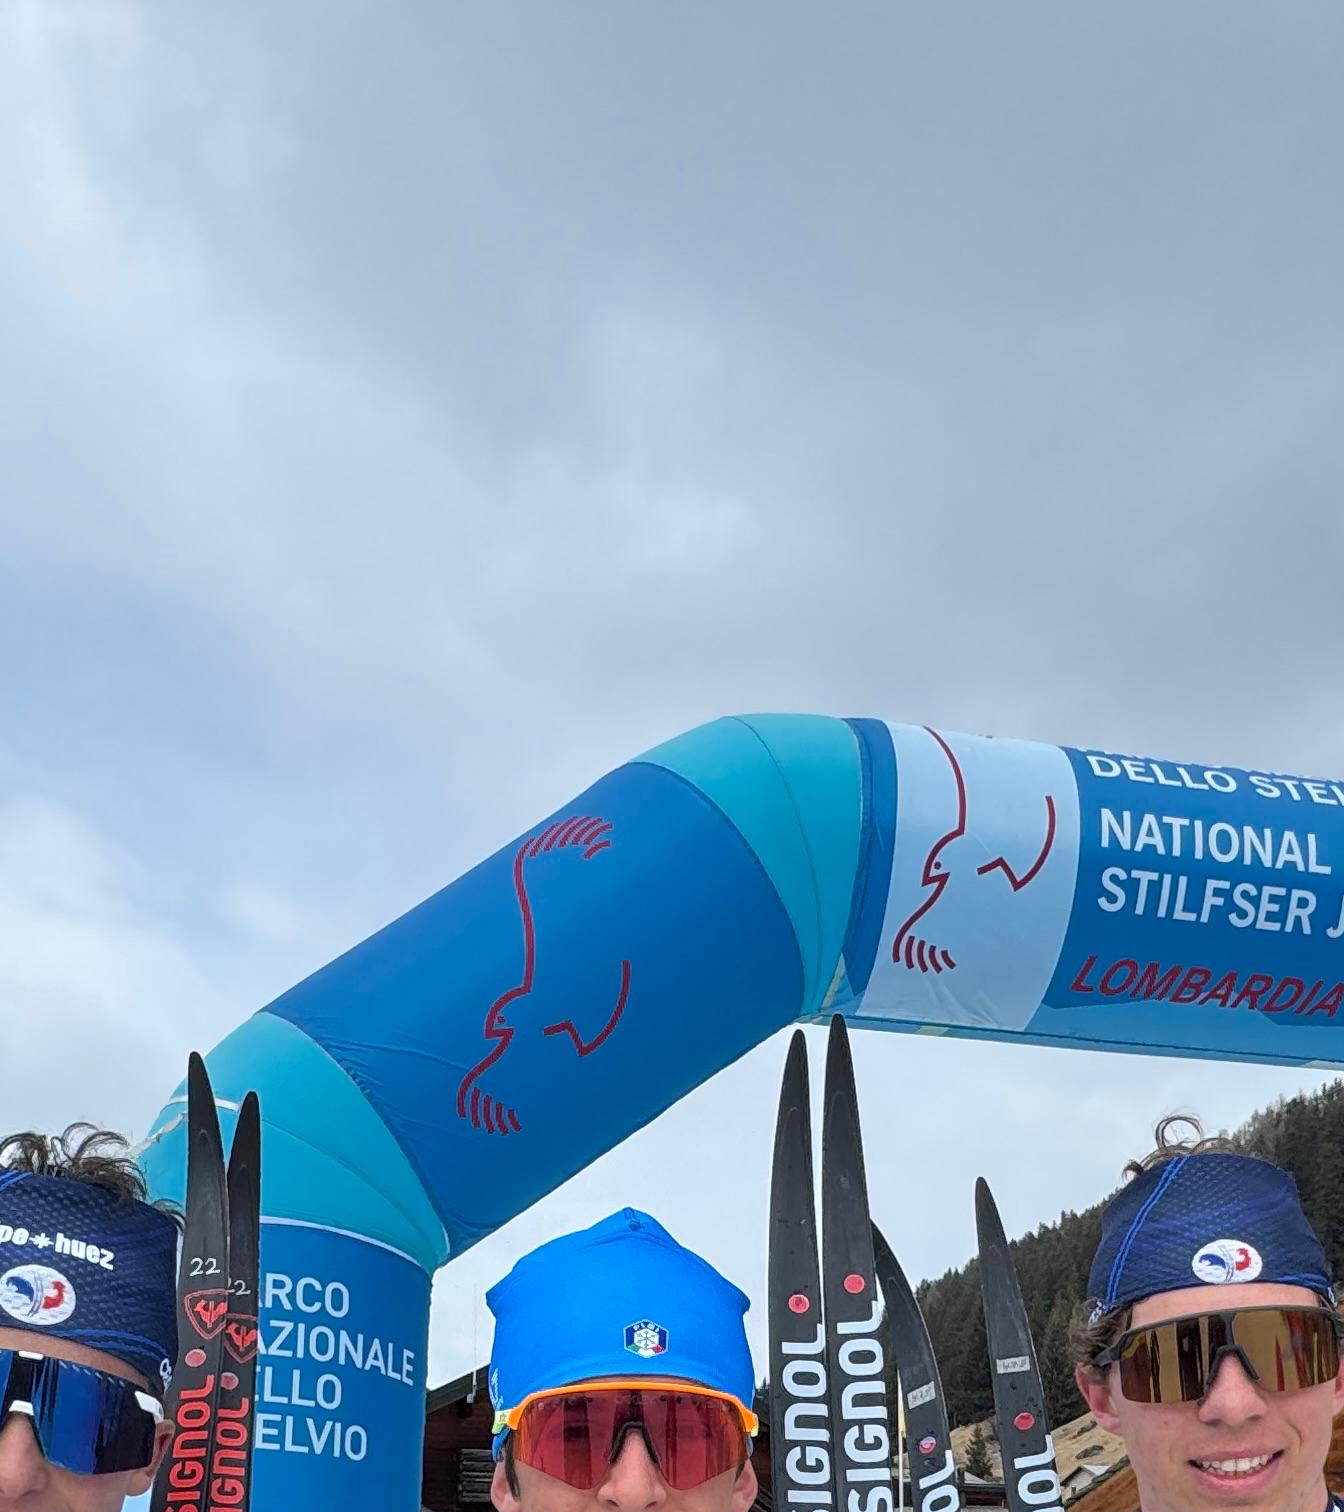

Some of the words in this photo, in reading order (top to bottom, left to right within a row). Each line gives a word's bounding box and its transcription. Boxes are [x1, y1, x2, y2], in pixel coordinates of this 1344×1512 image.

[1088, 755, 1237, 794] DELLO
[1100, 807, 1332, 876] NATIONAL
[1097, 866, 1318, 935] STILFSER
[54, 1232, 116, 1271] huez
[255, 1369, 342, 1410] LLO
[254, 1413, 368, 1461] ELVIO
